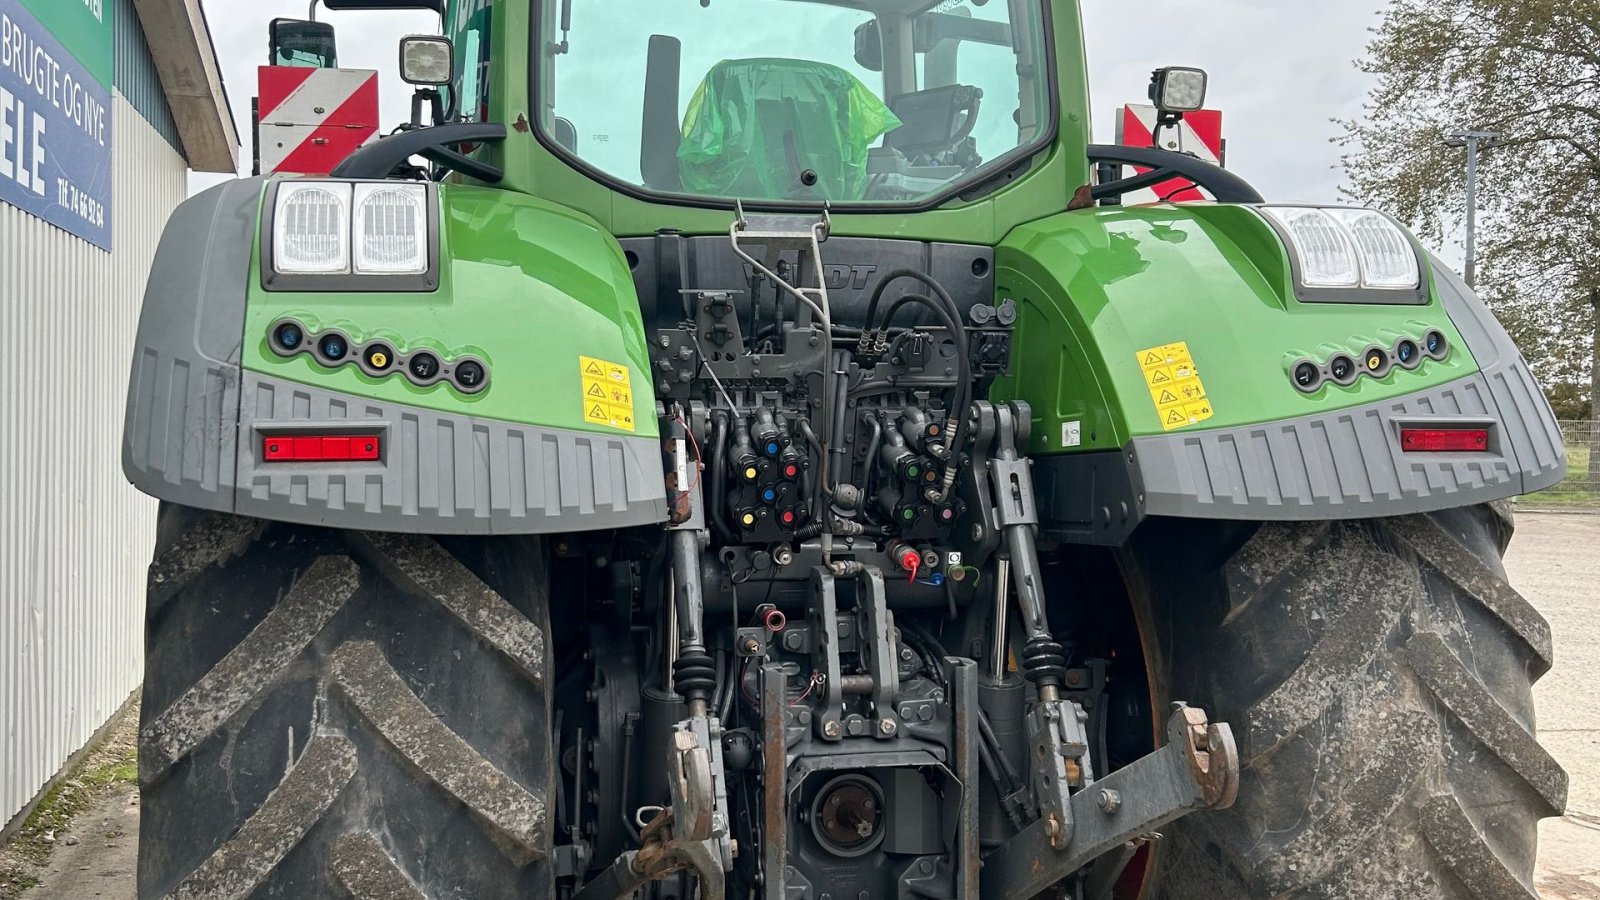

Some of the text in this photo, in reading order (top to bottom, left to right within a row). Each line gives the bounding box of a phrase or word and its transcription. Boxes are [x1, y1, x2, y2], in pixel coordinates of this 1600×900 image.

[3, 13, 105, 147] BRUGTE OG NYE
[0, 85, 46, 196] ELE
[58, 177, 104, 229] Tlf. 74 66 92 64
